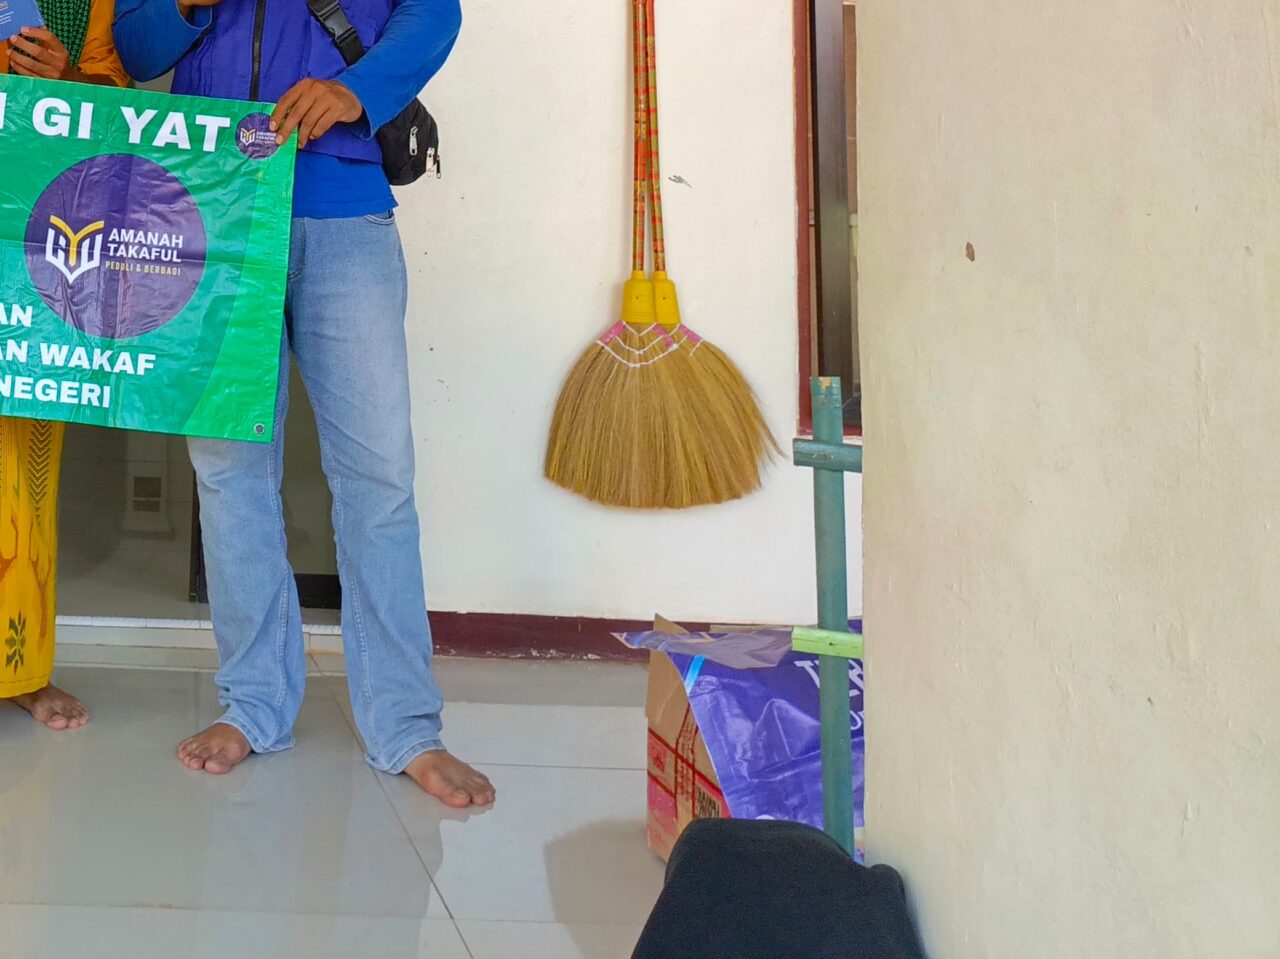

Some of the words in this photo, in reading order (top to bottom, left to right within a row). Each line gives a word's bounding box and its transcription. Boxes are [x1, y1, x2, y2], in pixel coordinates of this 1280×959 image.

[31, 97, 93, 139] GI
[120, 105, 231, 152] YAT
[107, 228, 184, 249] AMANAH
[106, 243, 182, 263] TAKAFUL
[105, 260, 134, 272] PEDULI
[40, 341, 157, 377] WAKAF
